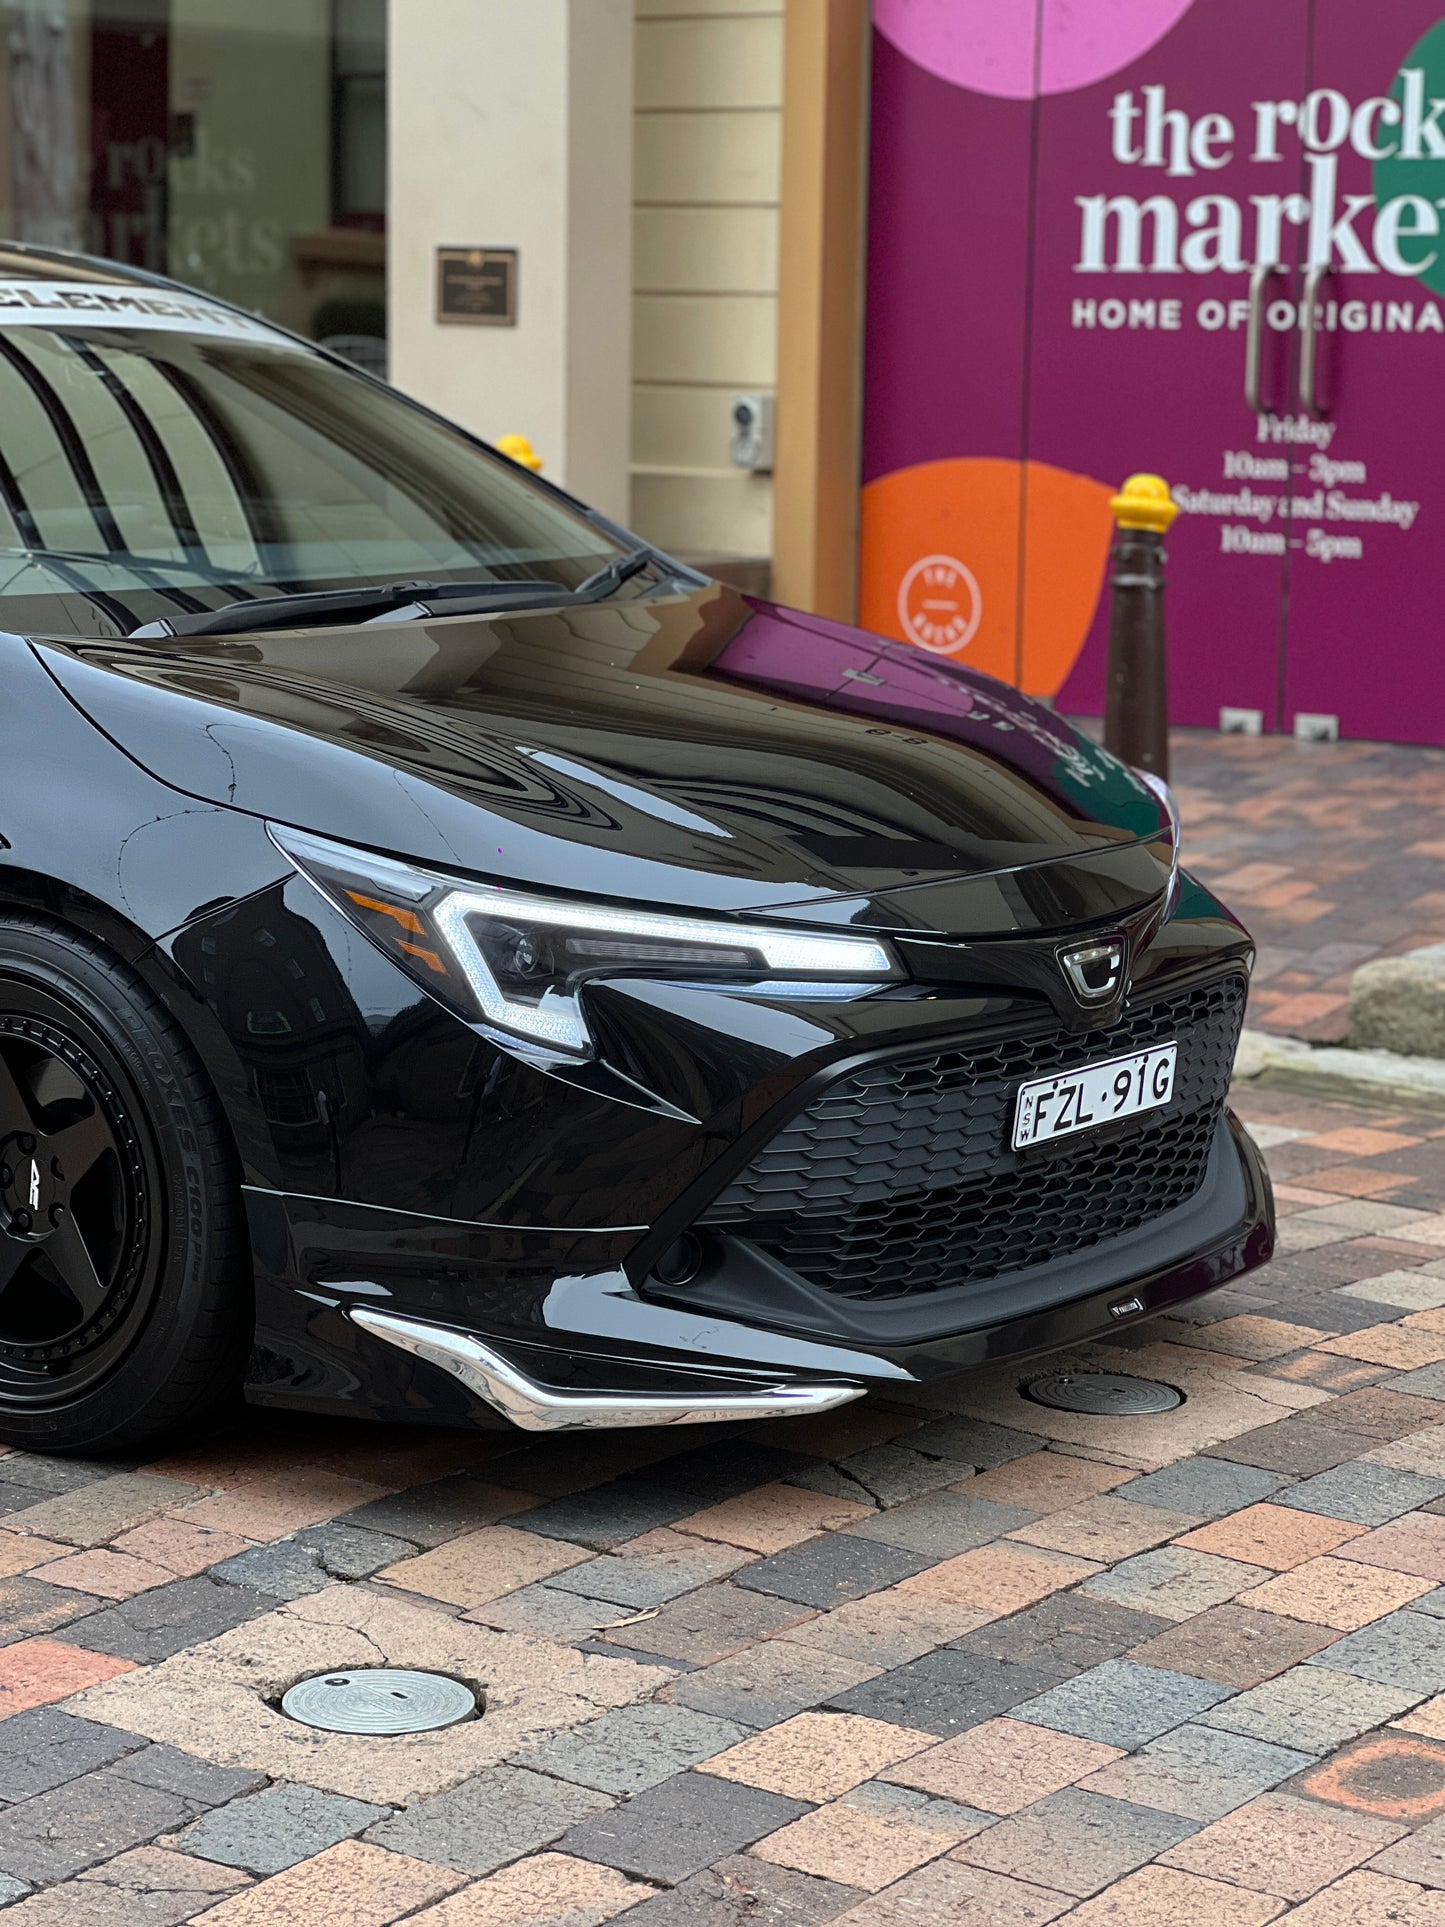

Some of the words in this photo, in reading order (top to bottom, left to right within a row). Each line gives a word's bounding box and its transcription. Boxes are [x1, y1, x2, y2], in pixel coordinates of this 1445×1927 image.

[1108, 84, 1235, 177] the
[1072, 152, 1445, 276] marke
[1071, 299, 1182, 331] HOME
[1196, 299, 1250, 331] OF
[1256, 413, 1336, 450] Friday
[1223, 451, 1289, 480] 10am
[1171, 483, 1278, 523] Saturday
[1277, 489, 1324, 520] and
[1326, 490, 1420, 530] Sunday
[1220, 525, 1286, 555] 10am
[1020, 1095, 1034, 1142] NSW
